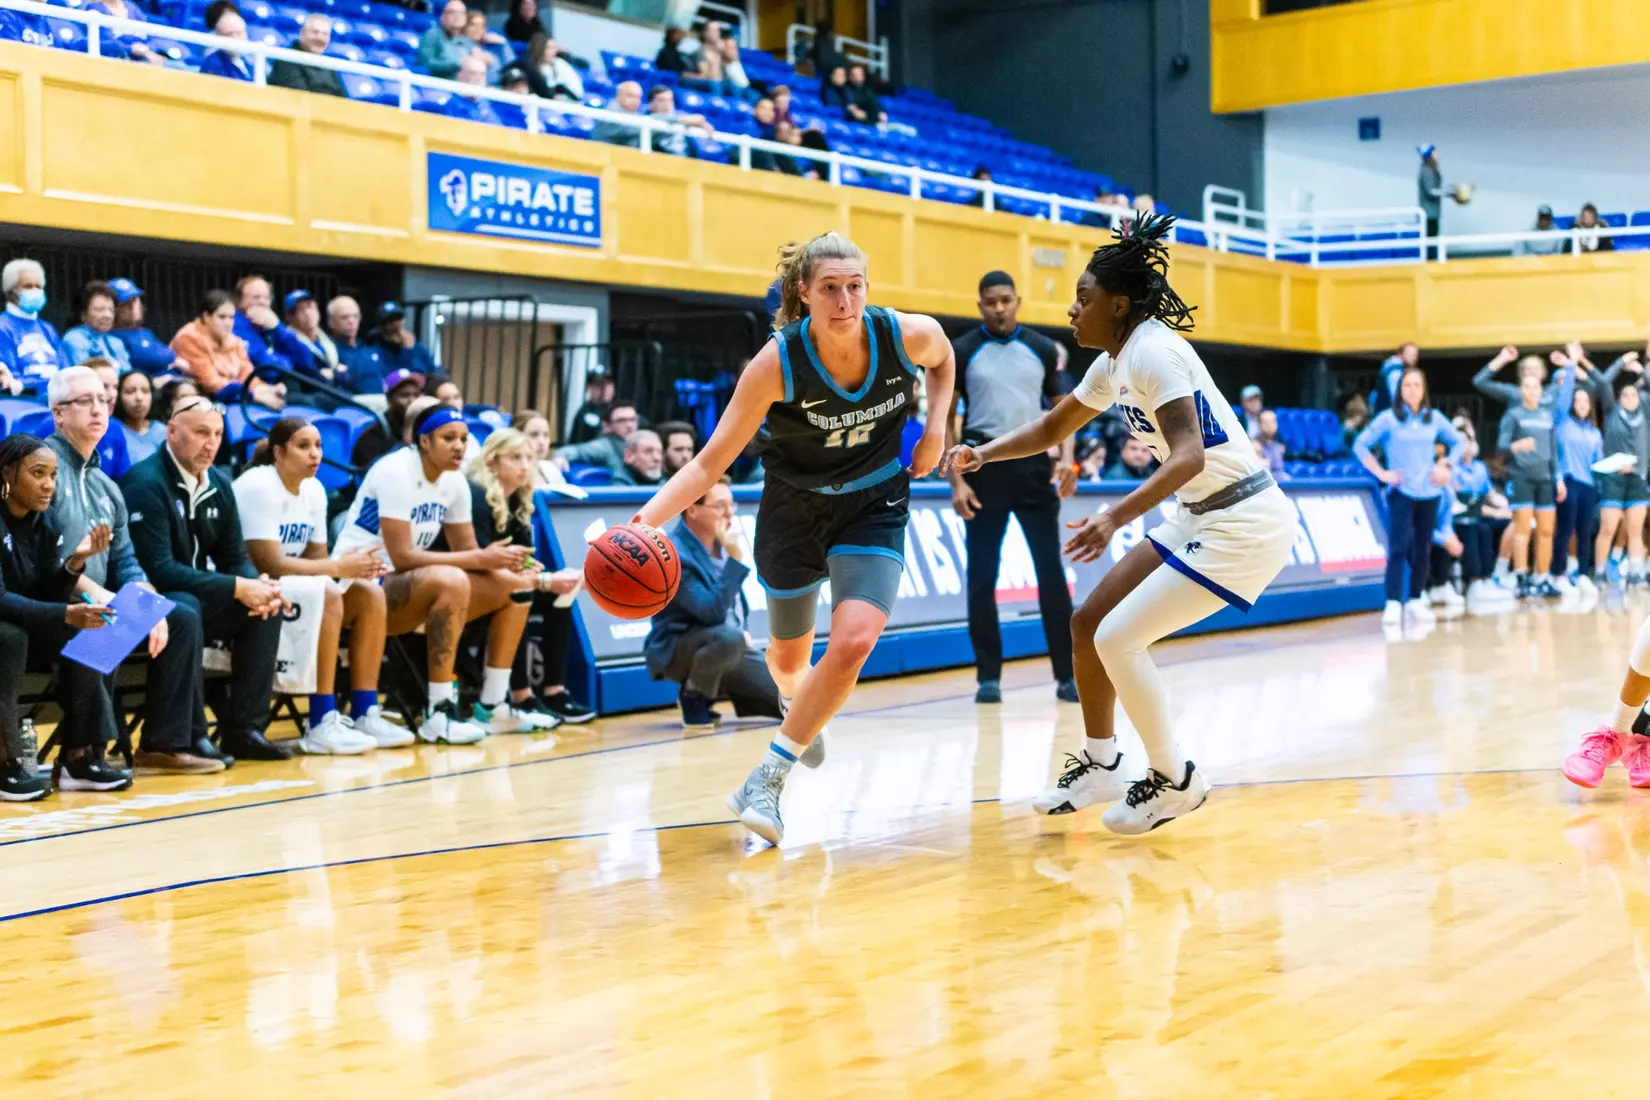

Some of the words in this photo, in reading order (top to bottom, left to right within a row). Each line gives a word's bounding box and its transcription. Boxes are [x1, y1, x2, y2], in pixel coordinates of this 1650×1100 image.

[471, 172, 595, 217] PIRATE
[469, 205, 594, 233] ATHLETICS
[806, 391, 906, 430] COLUMBIA
[607, 531, 651, 568] NCAA
